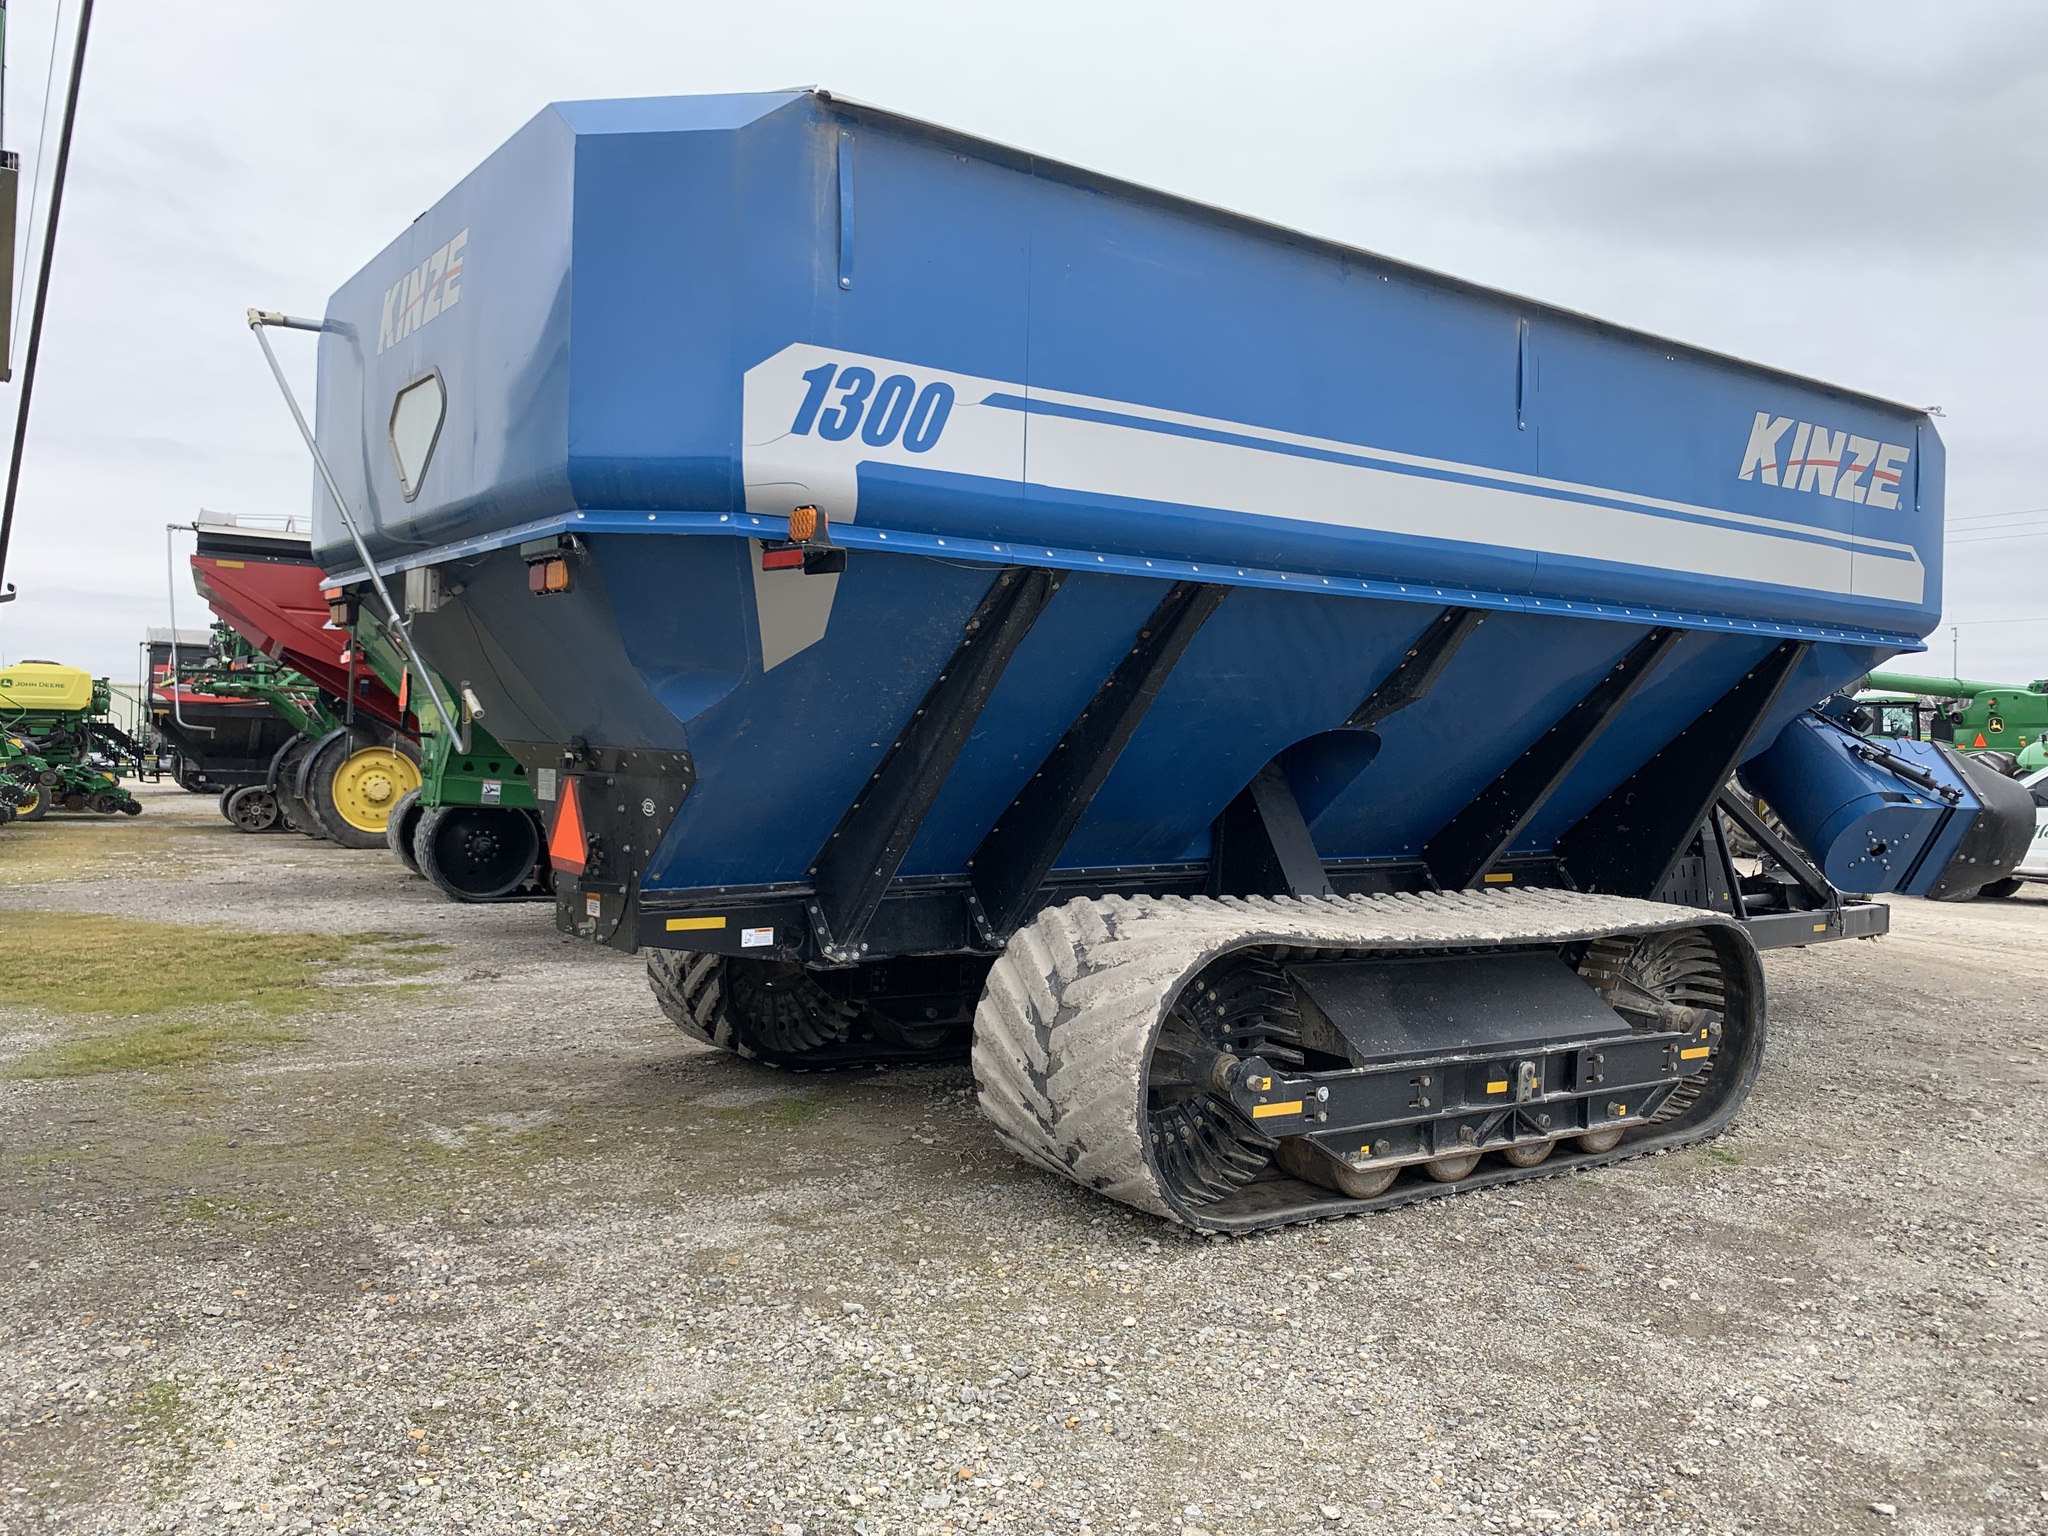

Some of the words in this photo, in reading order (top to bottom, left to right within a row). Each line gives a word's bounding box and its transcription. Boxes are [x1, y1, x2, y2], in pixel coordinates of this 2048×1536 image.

[377, 226, 469, 356] KINZE
[791, 363, 955, 453] 1300
[1738, 411, 1911, 510] KINZE
